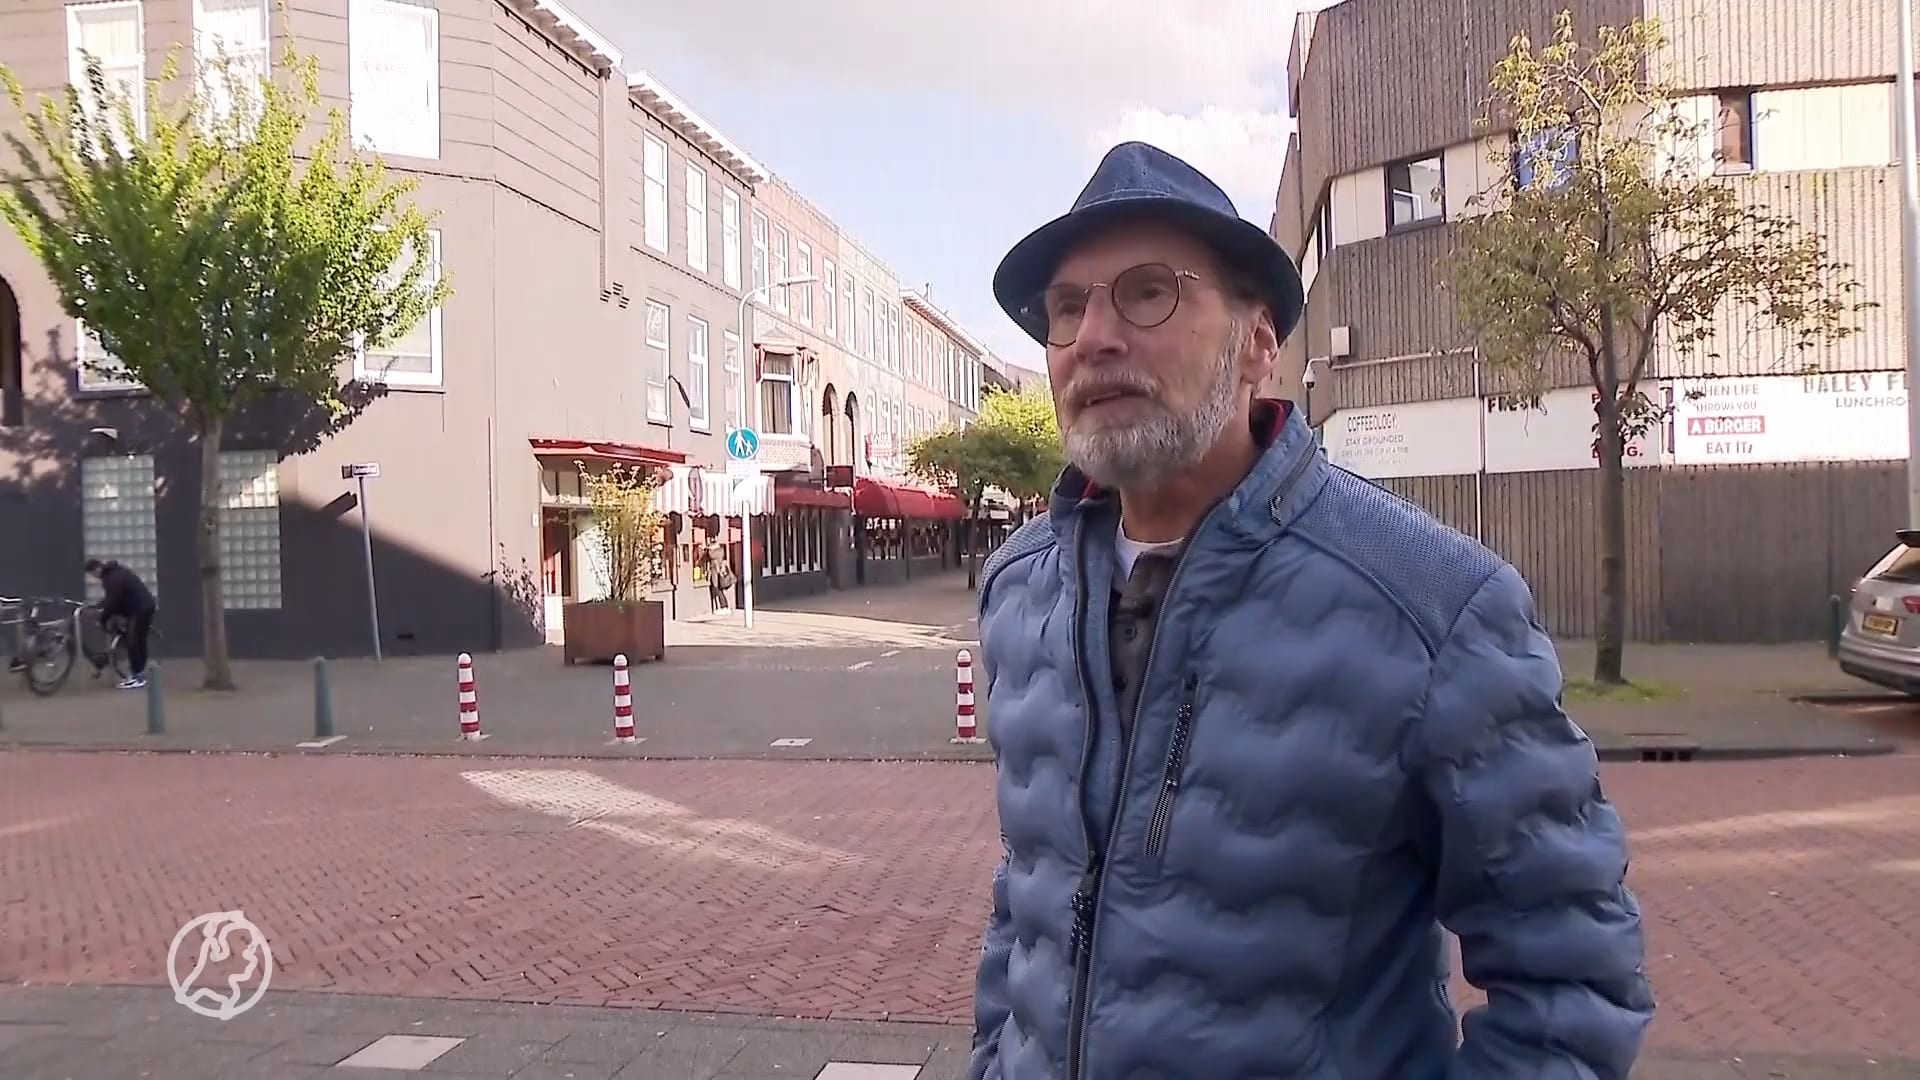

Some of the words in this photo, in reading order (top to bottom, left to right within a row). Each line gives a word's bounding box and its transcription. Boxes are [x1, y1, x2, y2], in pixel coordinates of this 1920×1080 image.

[1734, 383, 1760, 395] LIFE
[1737, 401, 1757, 410] YOU
[1691, 418, 1703, 434] A
[1704, 417, 1762, 433] BURGER
[1706, 441, 1731, 454] EAT
